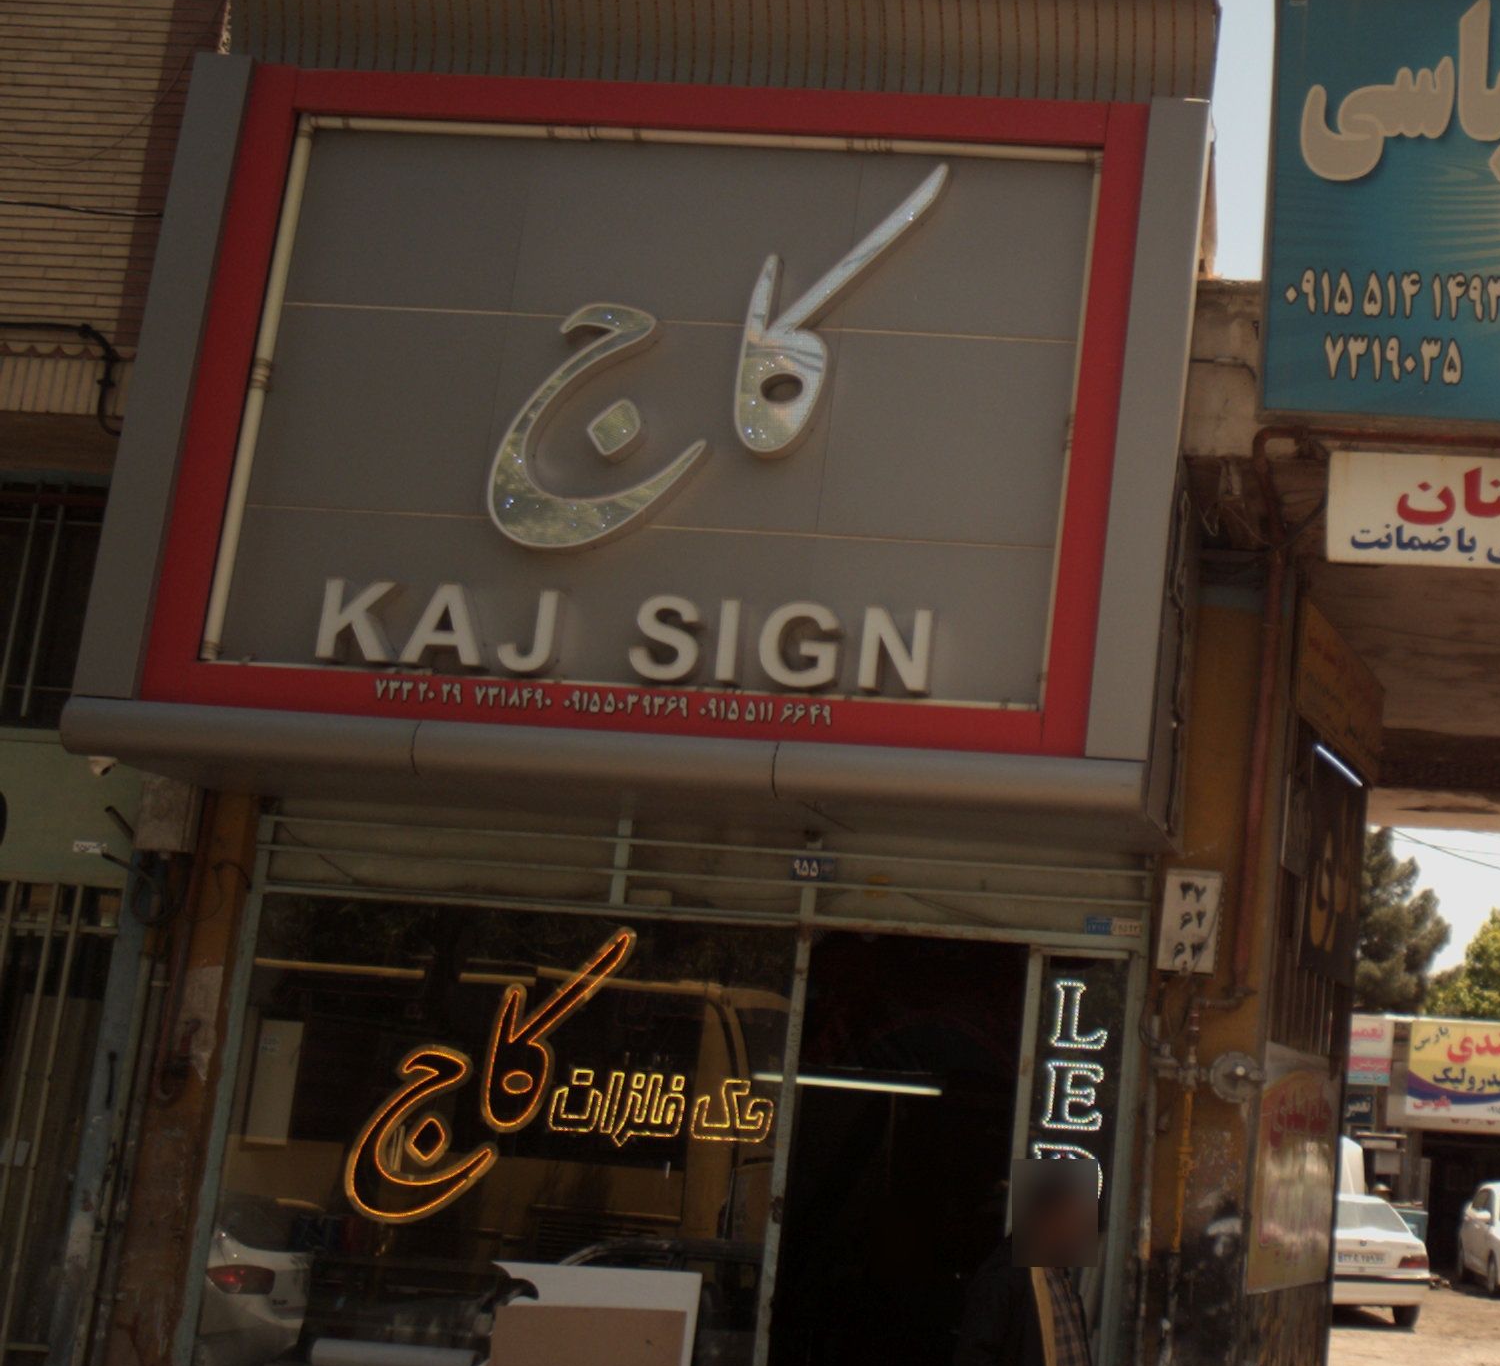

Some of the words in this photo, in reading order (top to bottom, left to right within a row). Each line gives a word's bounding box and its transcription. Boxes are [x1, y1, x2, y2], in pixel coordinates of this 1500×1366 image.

[1285, 266, 1353, 315] ۰۹۱۵
[1362, 269, 1421, 319] ۵۱۴
[484, 163, 951, 551] کاج
[1323, 332, 1462, 385] ۷۳۱۹۰۳۵
[314, 577, 566, 675] KAJ
[628, 593, 933, 695] SIGN
[345, 927, 636, 1223] کاج
